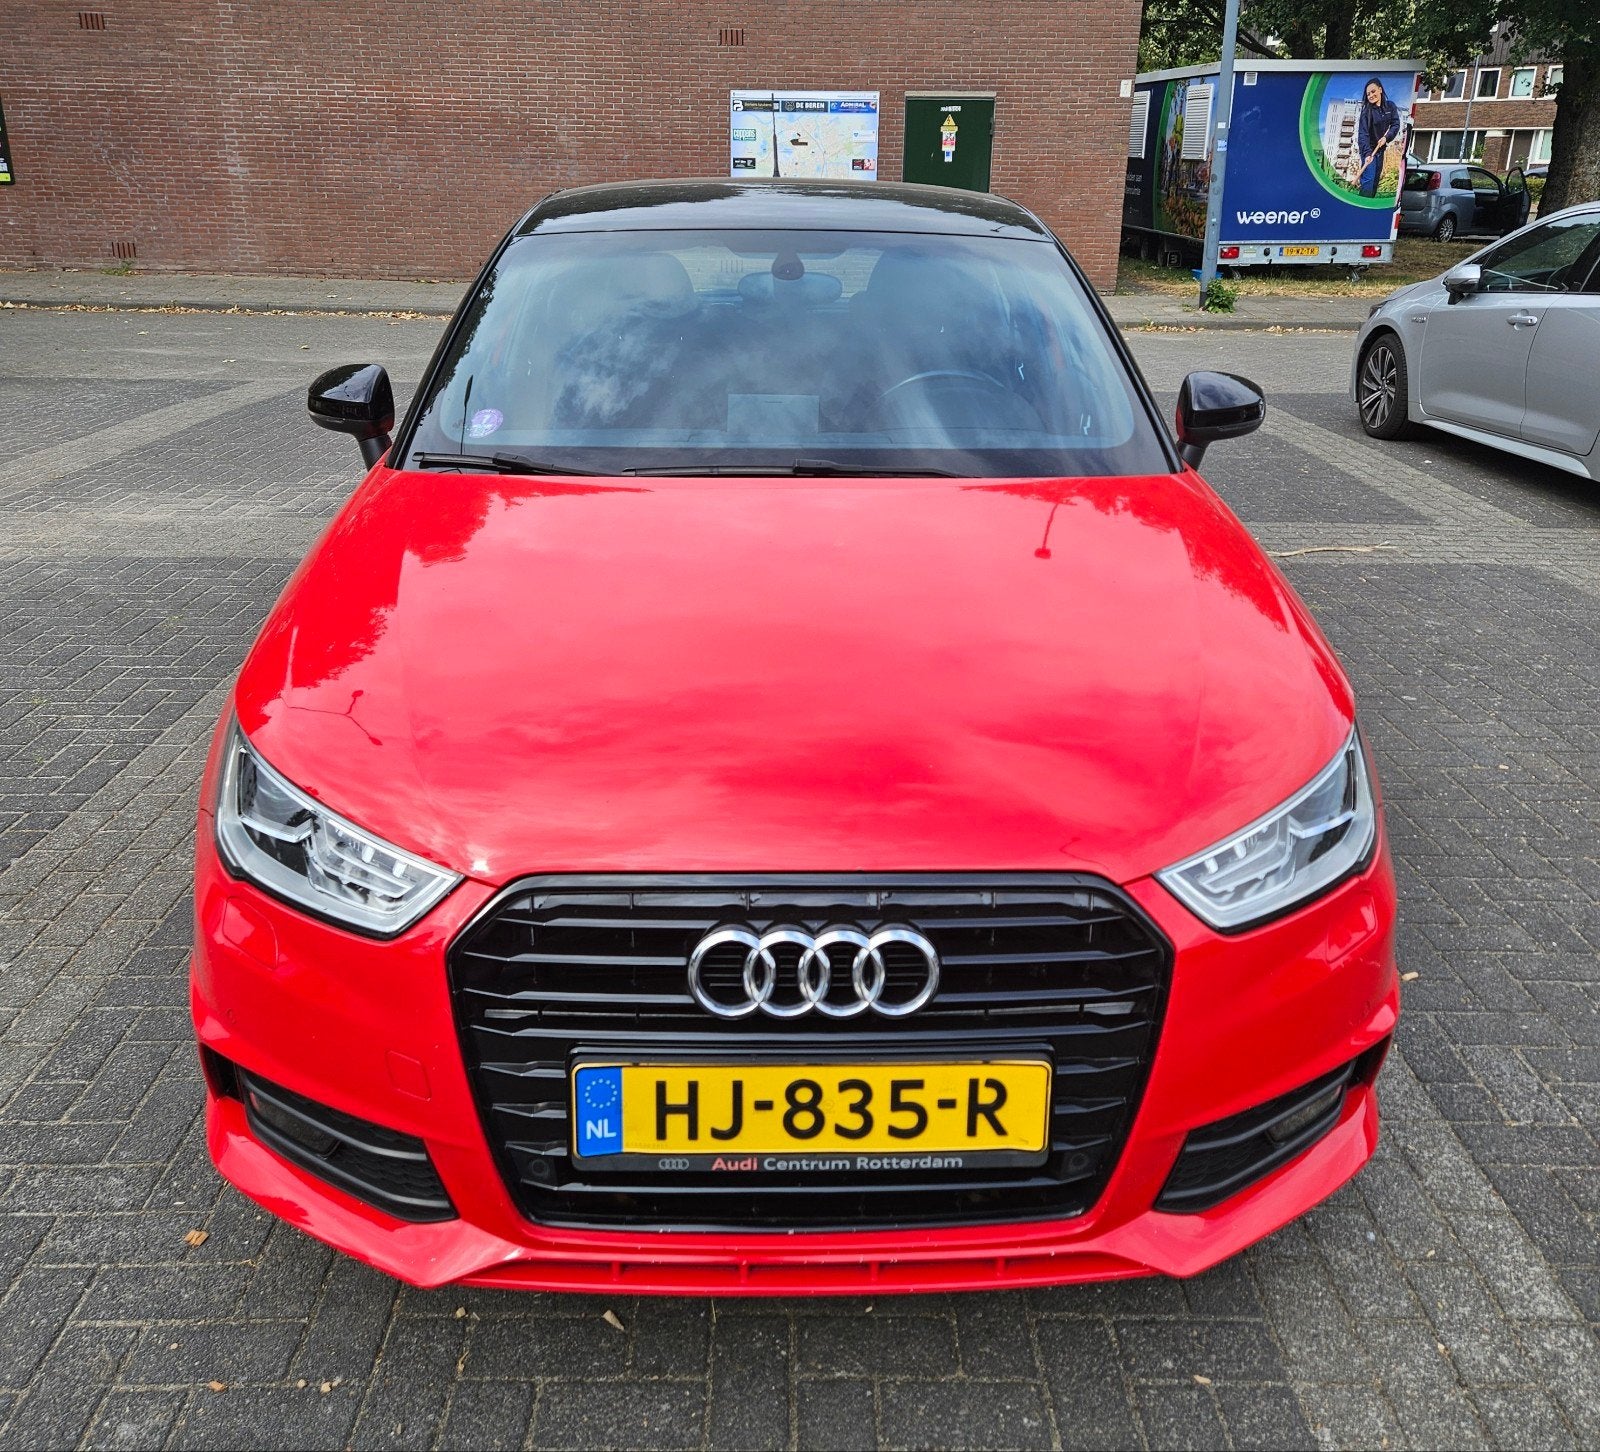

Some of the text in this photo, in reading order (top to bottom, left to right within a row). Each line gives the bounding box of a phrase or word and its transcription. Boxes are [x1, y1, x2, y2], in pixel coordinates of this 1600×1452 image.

[1236, 210, 1309, 225] weener
[655, 1077, 1009, 1141] HJ-835-R
[586, 1118, 617, 1140] NL
[711, 1155, 963, 1172] Audi Centrum Rotterdam
